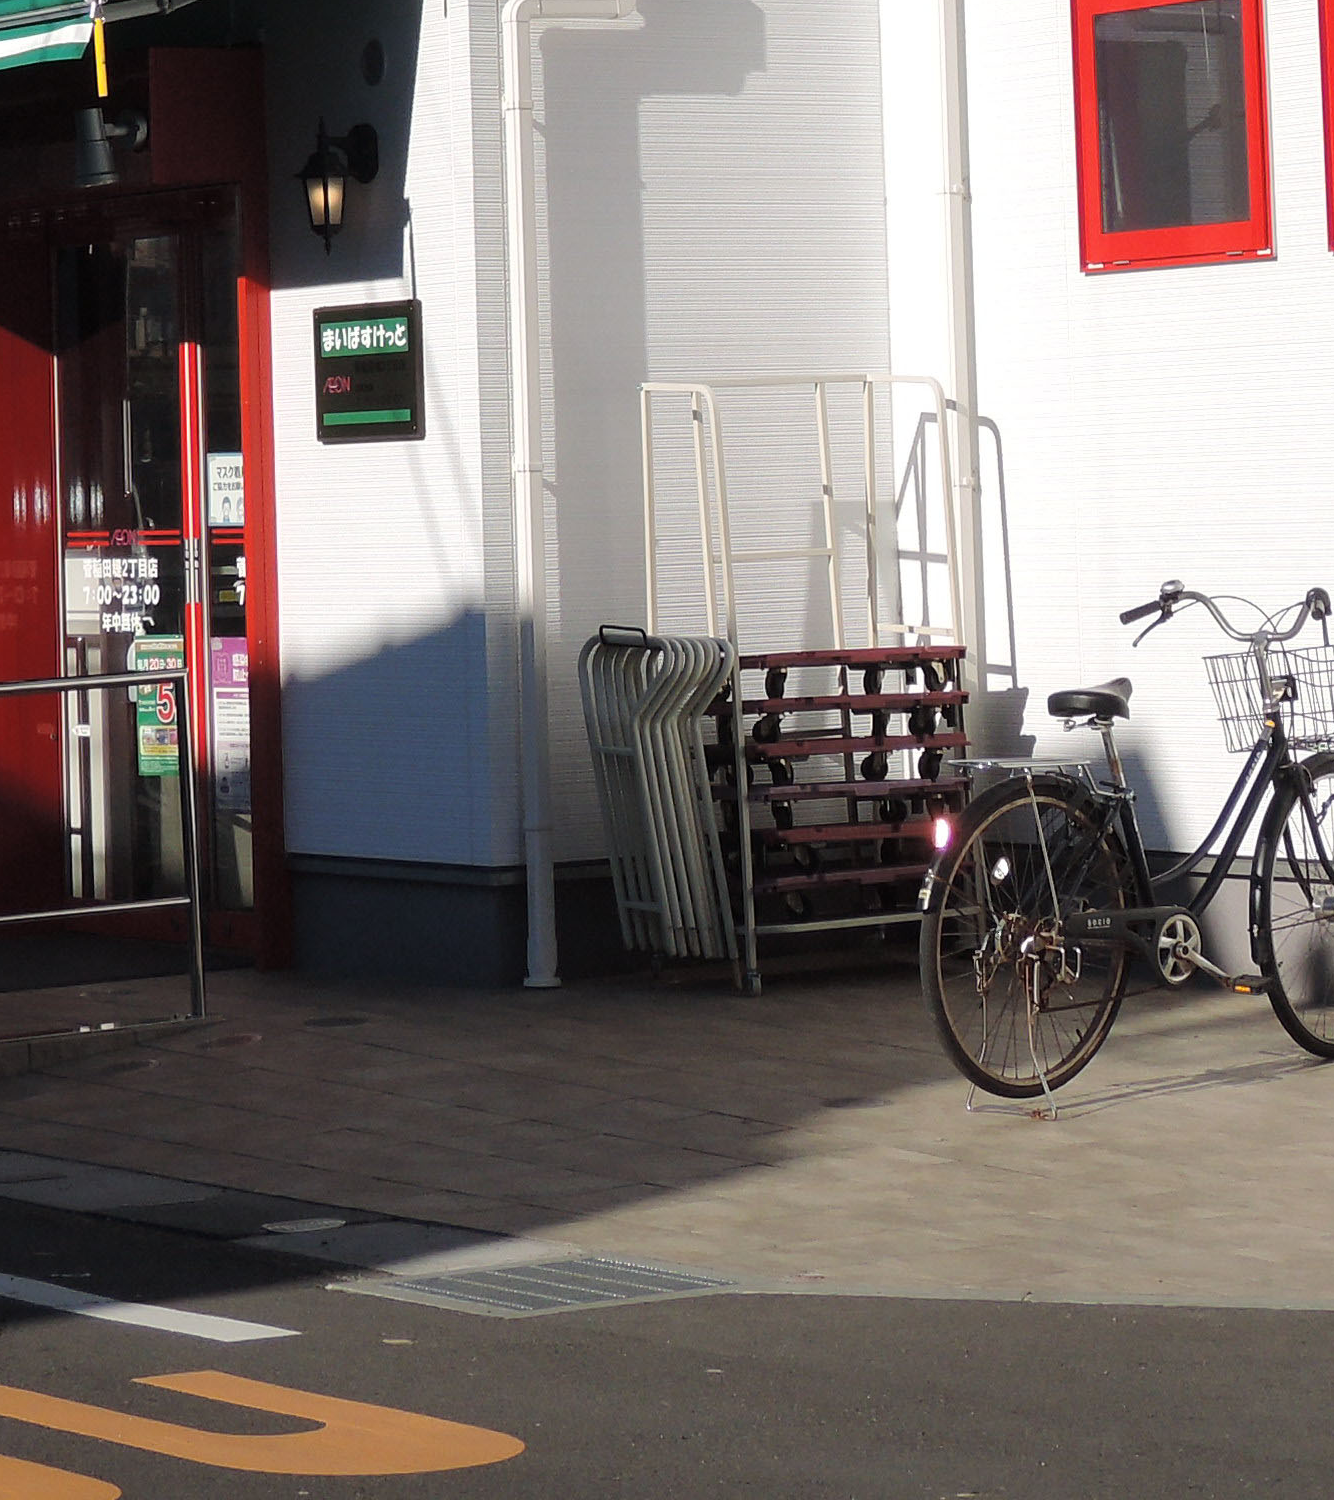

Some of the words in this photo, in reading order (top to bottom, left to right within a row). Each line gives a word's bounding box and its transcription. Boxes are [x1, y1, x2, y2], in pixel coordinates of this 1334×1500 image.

[322, 323, 407, 351] まいばすけっと
